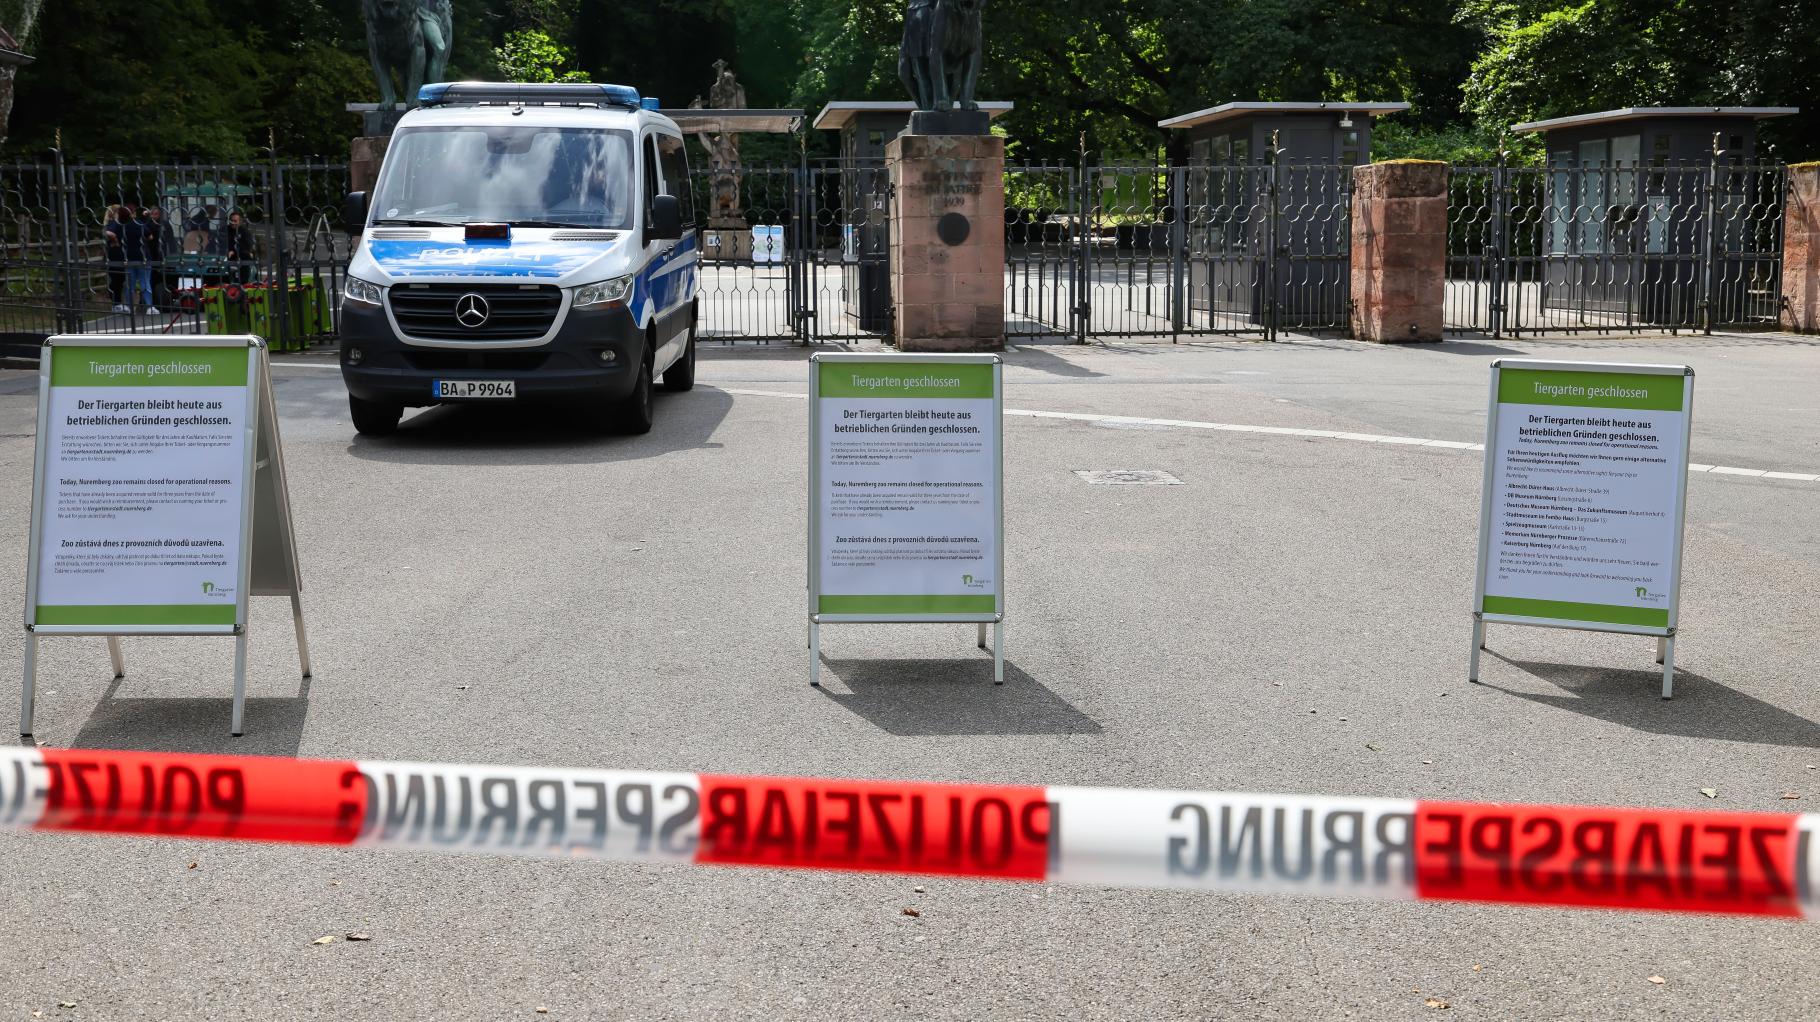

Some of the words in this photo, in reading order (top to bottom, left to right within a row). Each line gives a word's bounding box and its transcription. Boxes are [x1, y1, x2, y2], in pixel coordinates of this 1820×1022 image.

[89, 361, 144, 377] Tiergarten
[147, 361, 211, 377] geschlossen
[852, 375, 900, 389] Tiergarten
[903, 375, 960, 390] geschlossen
[441, 383, 458, 395] BA
[467, 383, 476, 395] P
[479, 383, 512, 395] 9964
[1534, 383, 1584, 398] Tiergarten
[1587, 386, 1648, 399] geschlossen
[78, 400, 94, 410] Der
[96, 400, 145, 411] Tiergarten
[147, 399, 175, 410] bleibt
[177, 400, 204, 410] heute
[206, 402, 222, 410] aus
[67, 415, 129, 425] betrieblichen
[131, 415, 171, 425] Gründen
[173, 415, 232, 427] geschlossen.
[844, 410, 857, 419] Der
[859, 410, 902, 421] Tiergarten
[905, 410, 929, 419] bleibt
[931, 410, 955, 419] heute
[1529, 414, 1542, 423] Der
[1544, 416, 1585, 427] Tiergarten
[1587, 418, 1611, 426] bleibt
[1612, 418, 1636, 428] heute
[1638, 421, 1652, 429] aus
[834, 424, 890, 433] betrieblichen
[892, 424, 926, 434] Gründen
[929, 424, 980, 434] geschlossen.
[1519, 427, 1571, 437] betrieblichen
[1573, 430, 1607, 439] Gründen
[1609, 432, 1659, 442] geschlossen.
[62, 539, 74, 548] Zoo
[75, 539, 101, 548] zůstává
[102, 539, 119, 548] dnes
[120, 539, 124, 548] z
[126, 539, 162, 548] provozních
[164, 539, 189, 548] důvodů
[191, 539, 224, 548] uzavřena.
[836, 536, 847, 544] Zoo
[848, 536, 872, 544] zůstává
[872, 536, 887, 544] dnes
[888, 536, 892, 544] z
[892, 536, 925, 544] provozních
[927, 536, 949, 544] důvodů
[950, 536, 980, 544] uzavřena.
